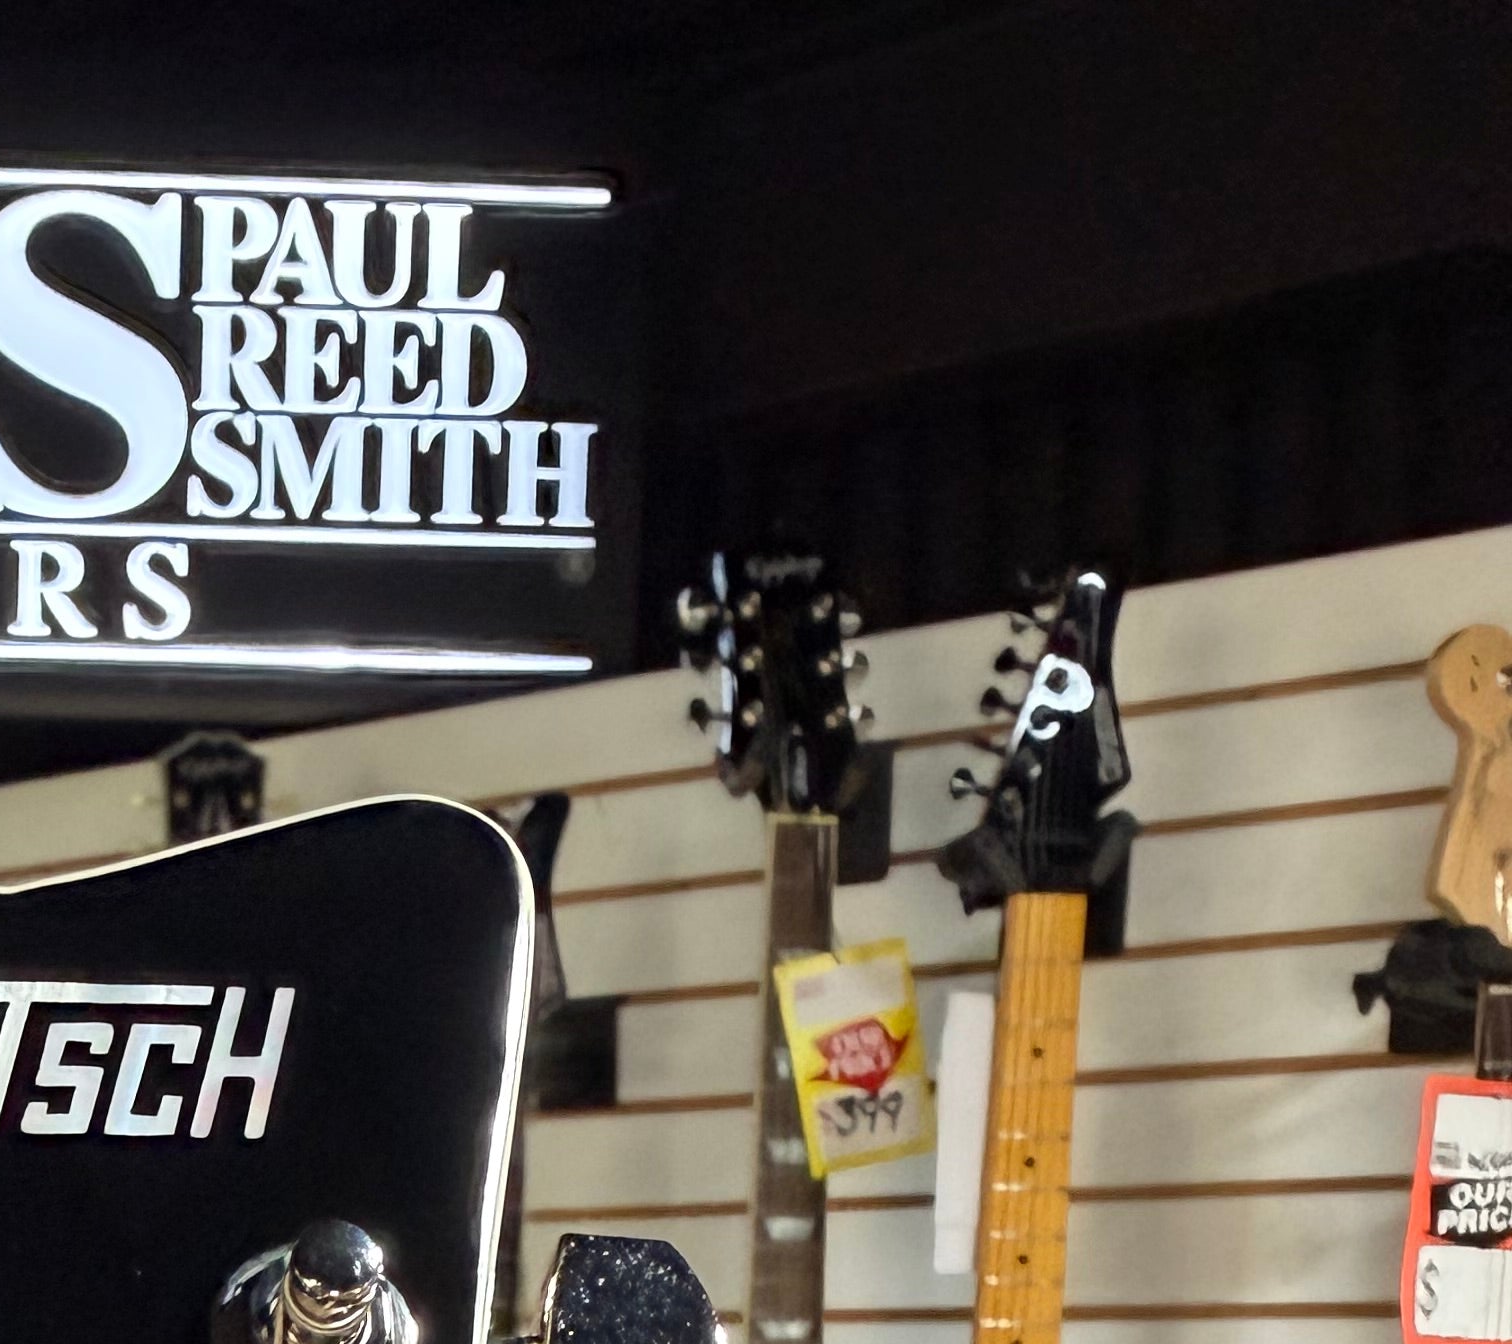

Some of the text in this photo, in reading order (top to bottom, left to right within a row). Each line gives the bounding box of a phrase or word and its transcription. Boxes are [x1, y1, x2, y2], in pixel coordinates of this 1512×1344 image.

[191, 194, 506, 312] PAUL
[191, 304, 529, 418] REED
[186, 412, 599, 529] SMITH
[1437, 1204, 1512, 1236] PRIC
